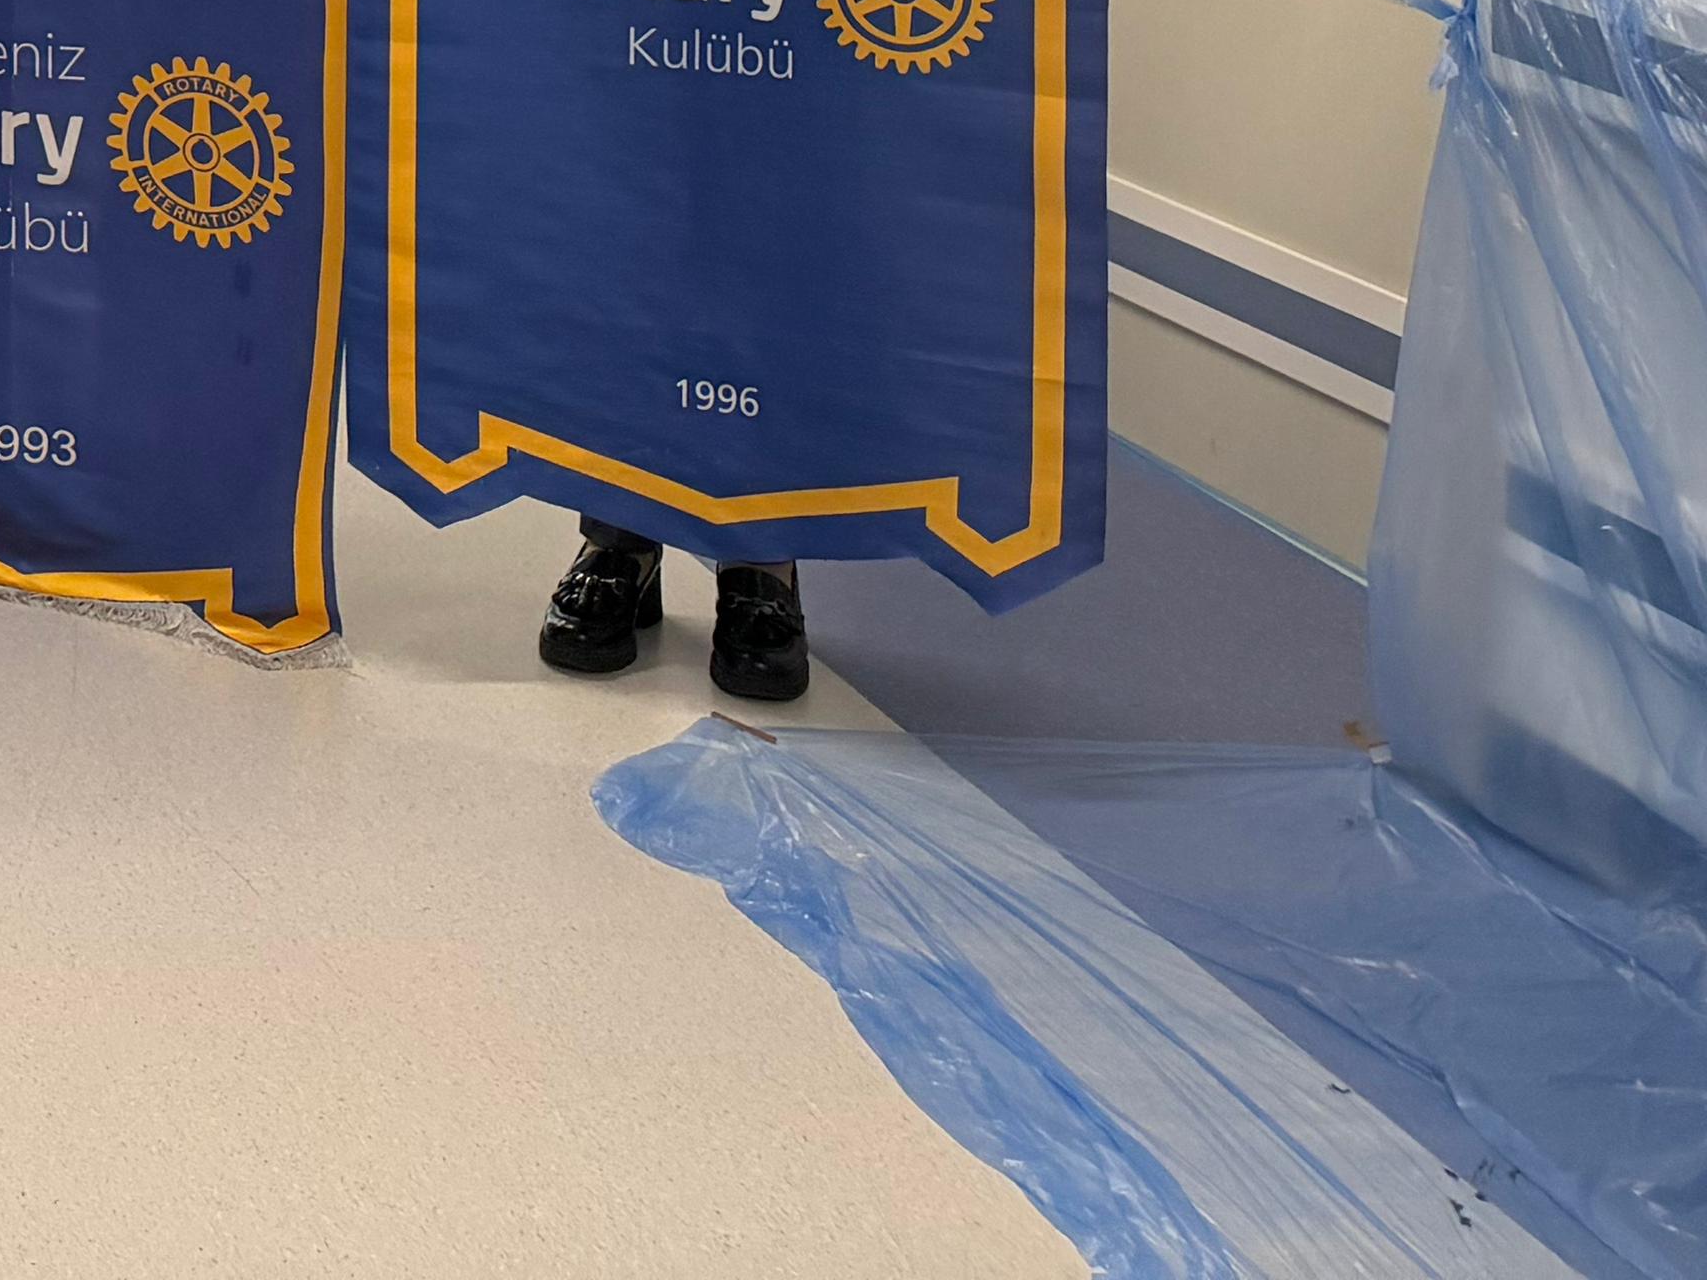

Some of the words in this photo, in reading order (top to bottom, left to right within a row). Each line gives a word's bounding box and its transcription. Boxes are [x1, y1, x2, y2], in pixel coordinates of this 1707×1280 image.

[627, 28, 795, 80] Kulübü
[164, 78, 241, 103] ROTARY
[139, 175, 267, 227] INTERNATIONAL
[676, 378, 760, 418] 1996
